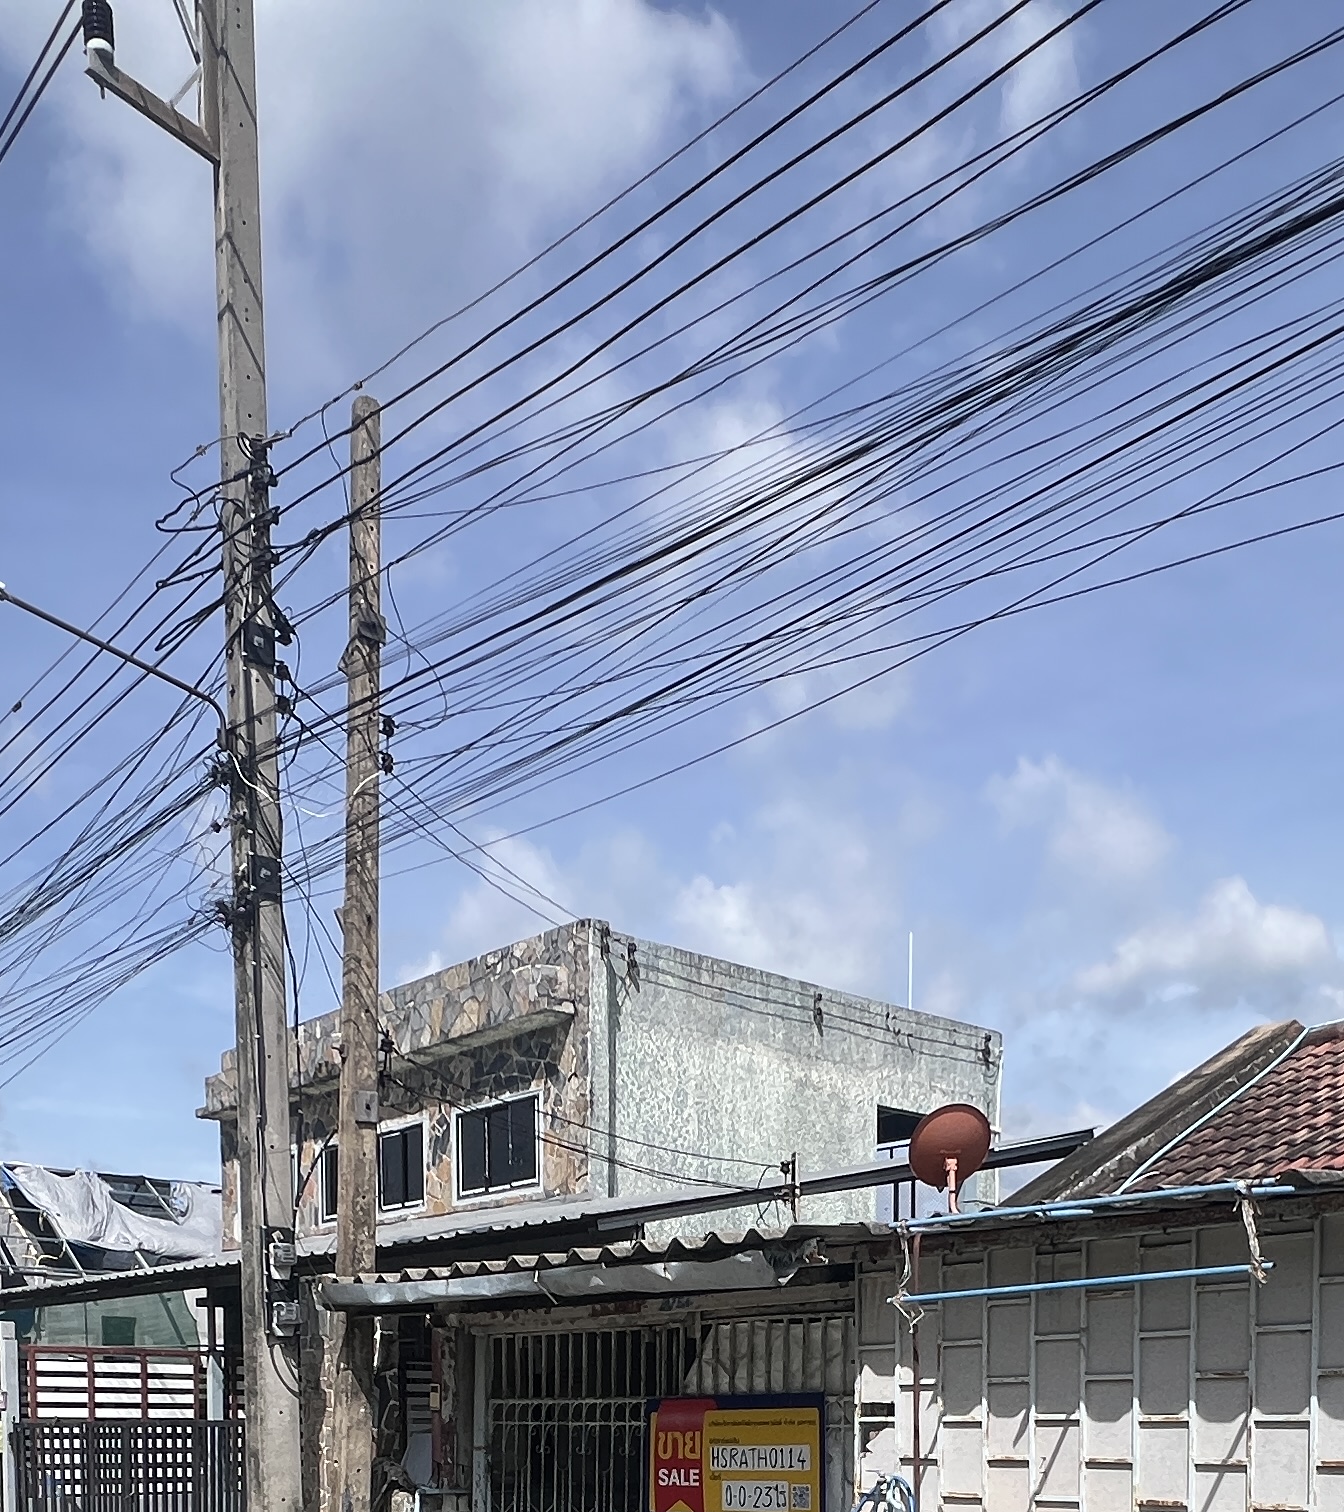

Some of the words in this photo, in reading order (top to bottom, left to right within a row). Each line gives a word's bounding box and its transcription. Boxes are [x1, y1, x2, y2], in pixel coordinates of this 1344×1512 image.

[658, 1430, 701, 1460] ขาย
[711, 1447, 807, 1470] HSRATH0114
[658, 1468, 700, 1487] SALE
